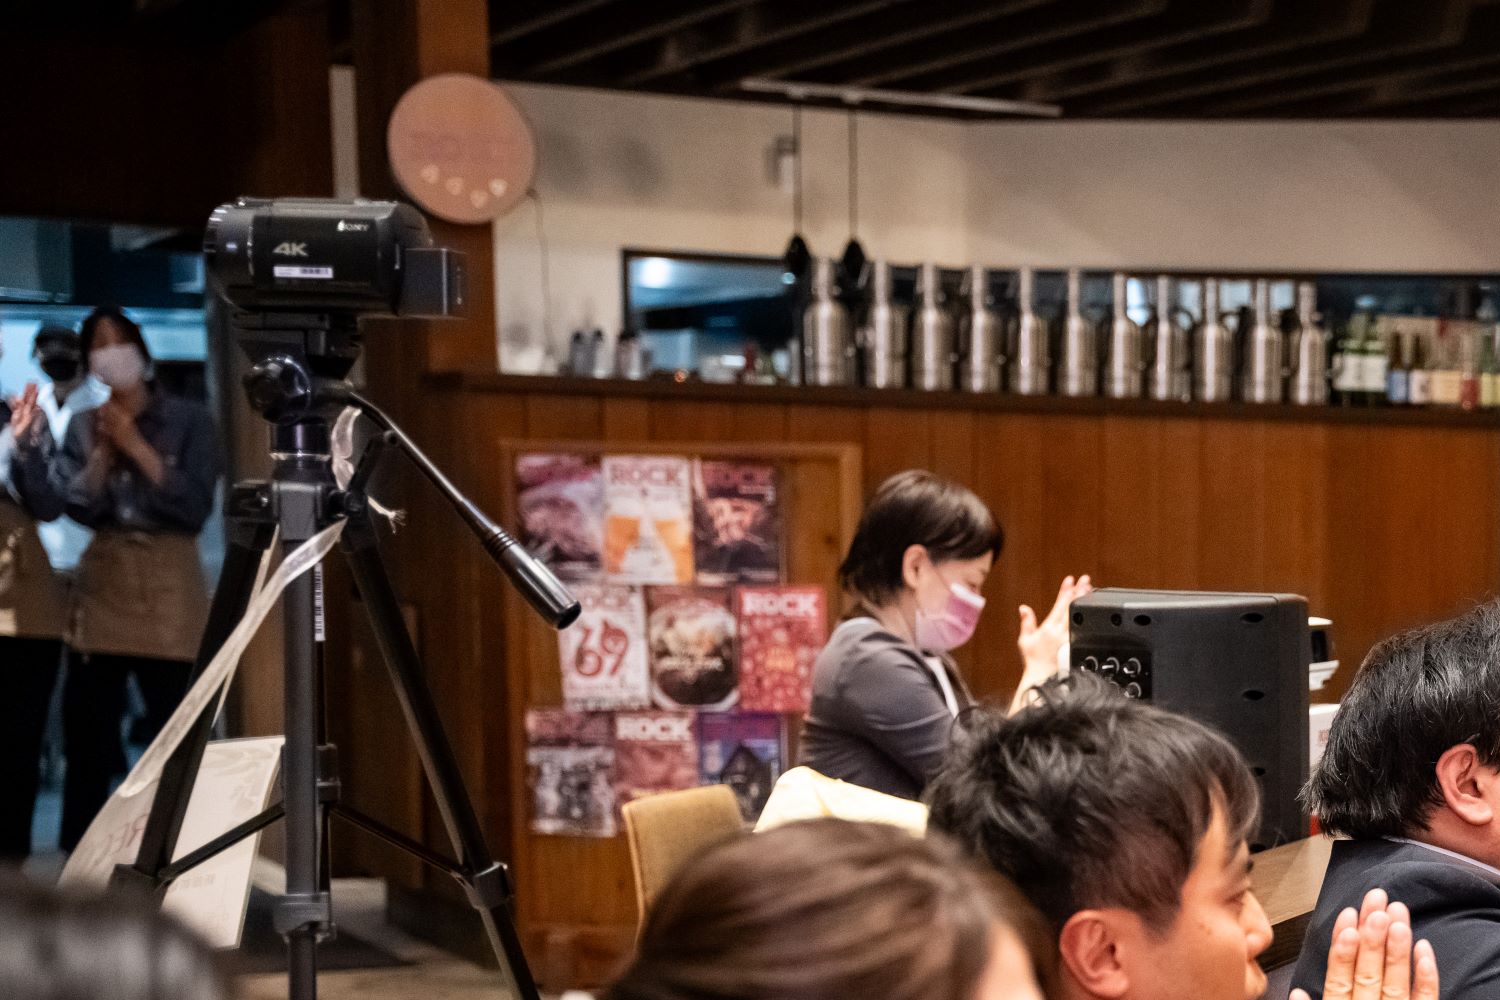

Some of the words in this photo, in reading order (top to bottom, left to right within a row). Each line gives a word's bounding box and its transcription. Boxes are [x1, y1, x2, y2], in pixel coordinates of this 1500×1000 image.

[273, 242, 308, 257] 4K
[741, 591, 820, 617] ROCK
[574, 618, 629, 677] 69
[615, 715, 695, 742] ROCK
